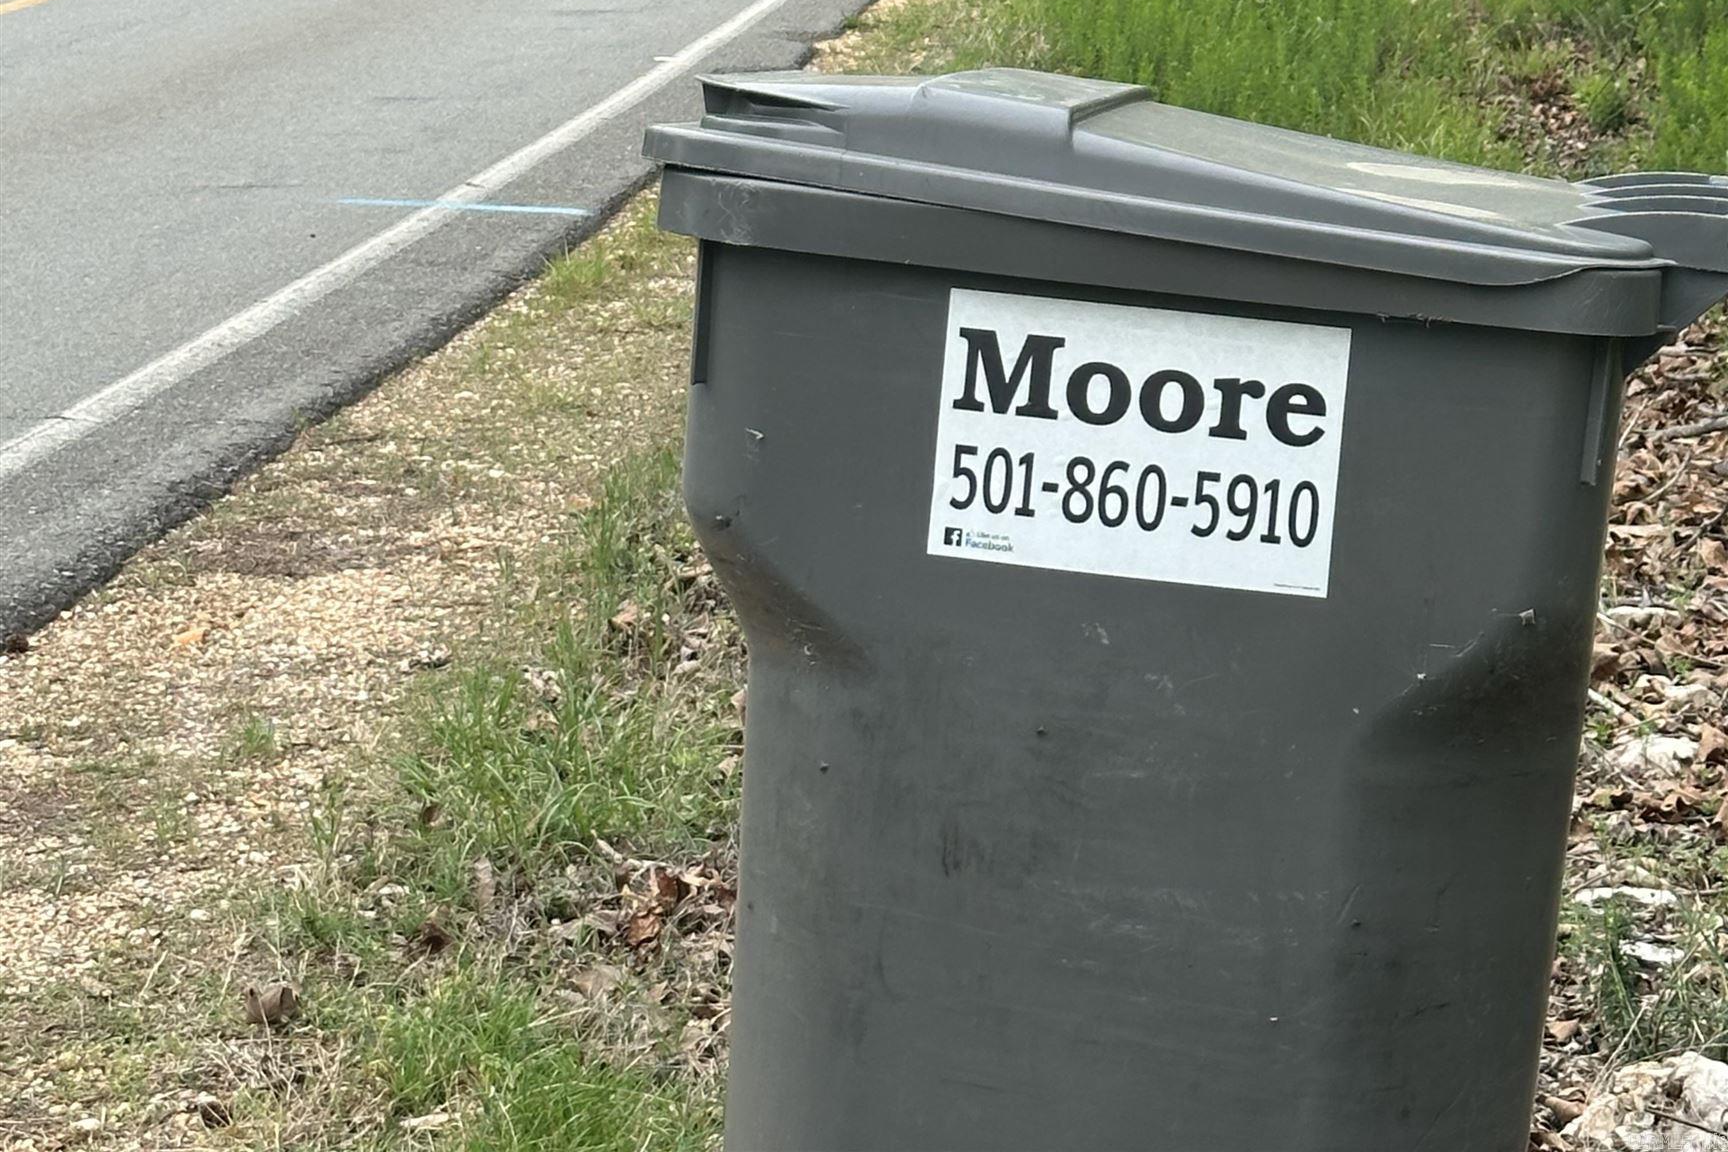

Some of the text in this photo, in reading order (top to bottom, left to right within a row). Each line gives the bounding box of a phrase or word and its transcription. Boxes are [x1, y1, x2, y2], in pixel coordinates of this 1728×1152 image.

[952, 327, 1327, 447] Moore
[949, 444, 1320, 548] 501-860-5910
[965, 538, 1014, 552] Facebook
